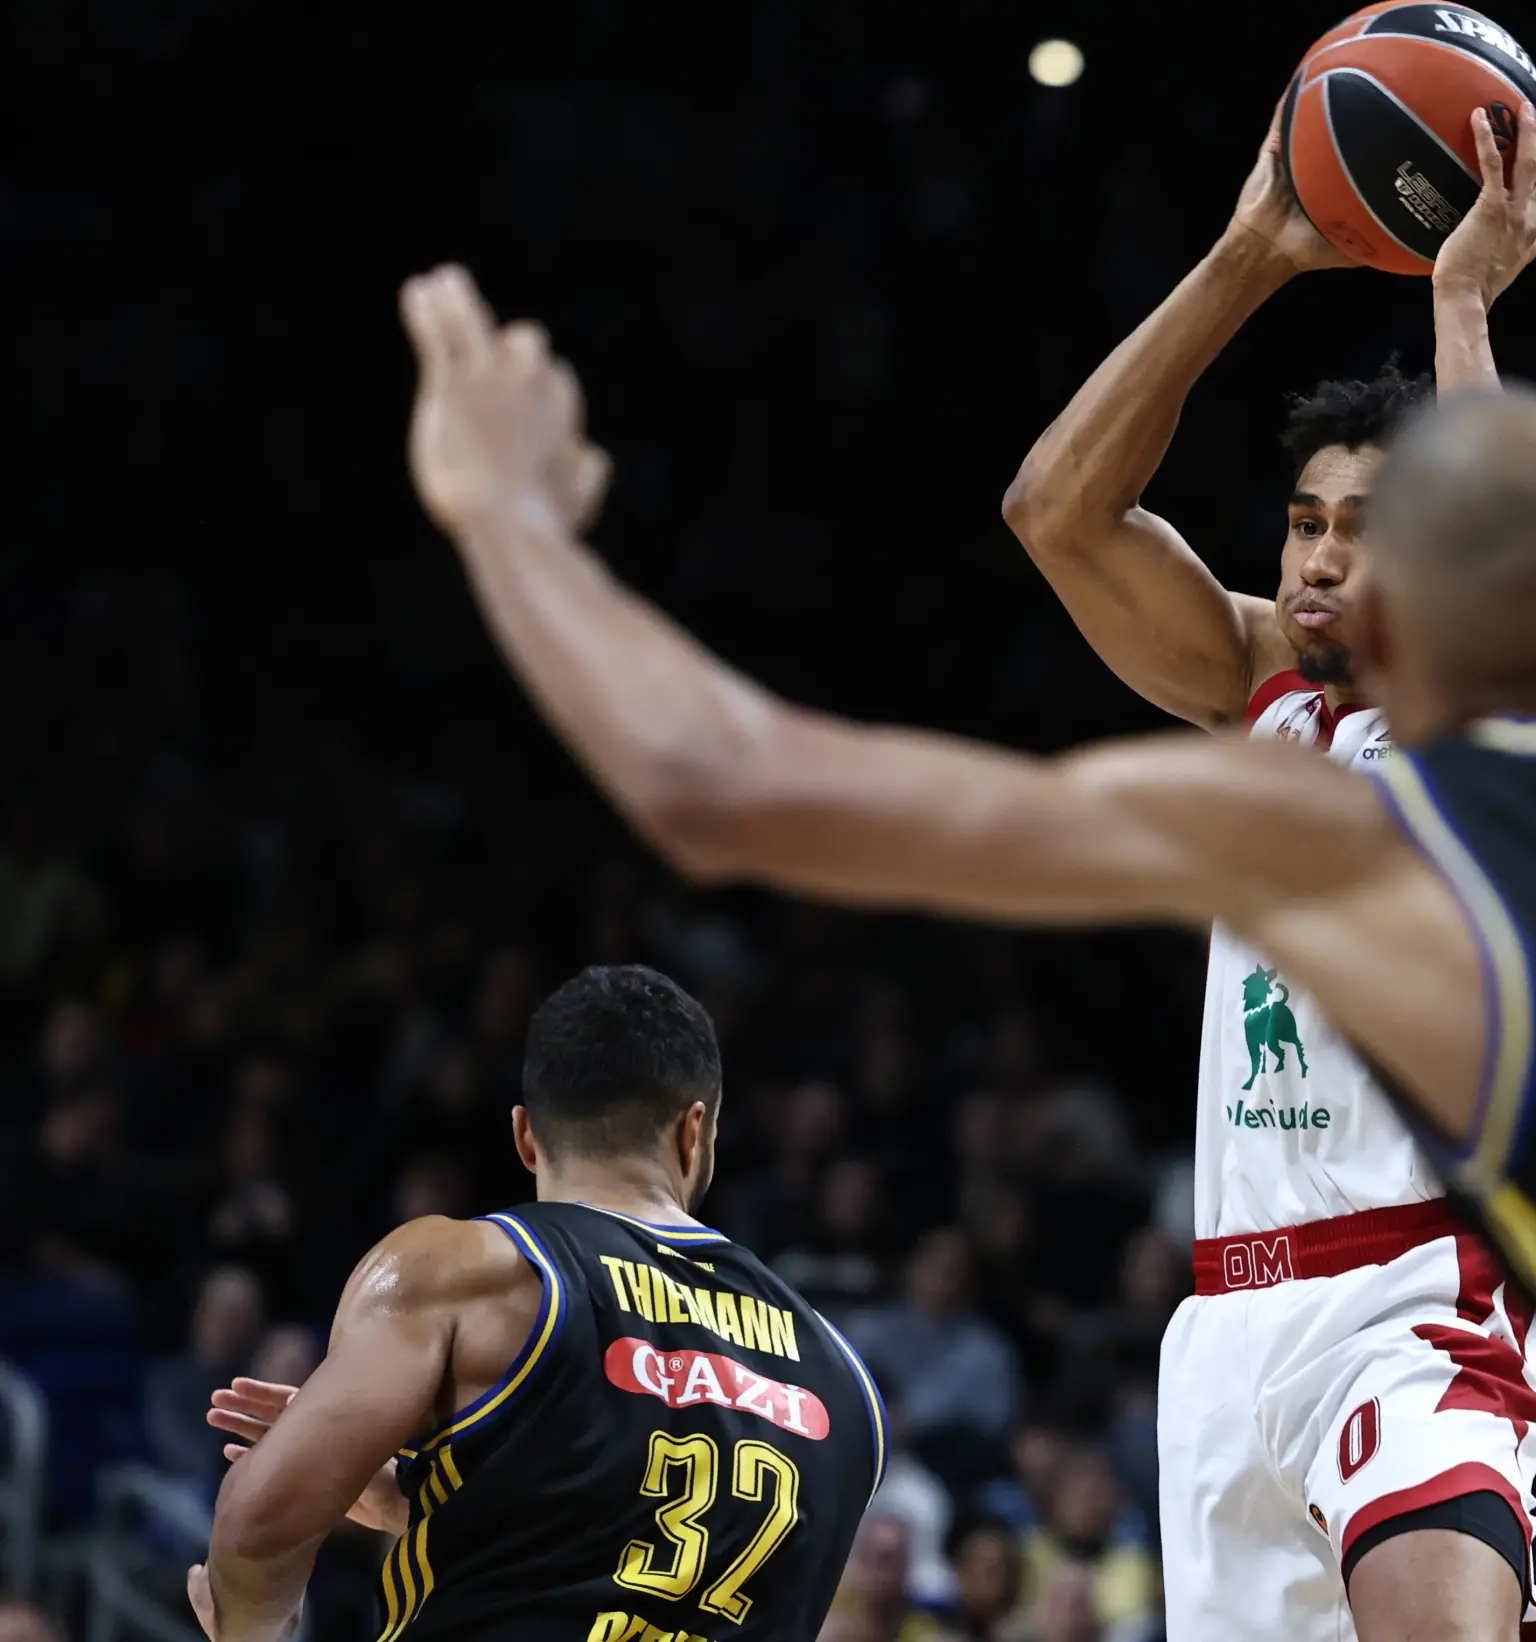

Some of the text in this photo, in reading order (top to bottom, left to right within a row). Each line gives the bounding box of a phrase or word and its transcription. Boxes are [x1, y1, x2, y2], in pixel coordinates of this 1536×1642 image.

[599, 1255, 801, 1362] THIEMANN
[1223, 1236, 1294, 1288] OM
[612, 1430, 799, 1625] 32
